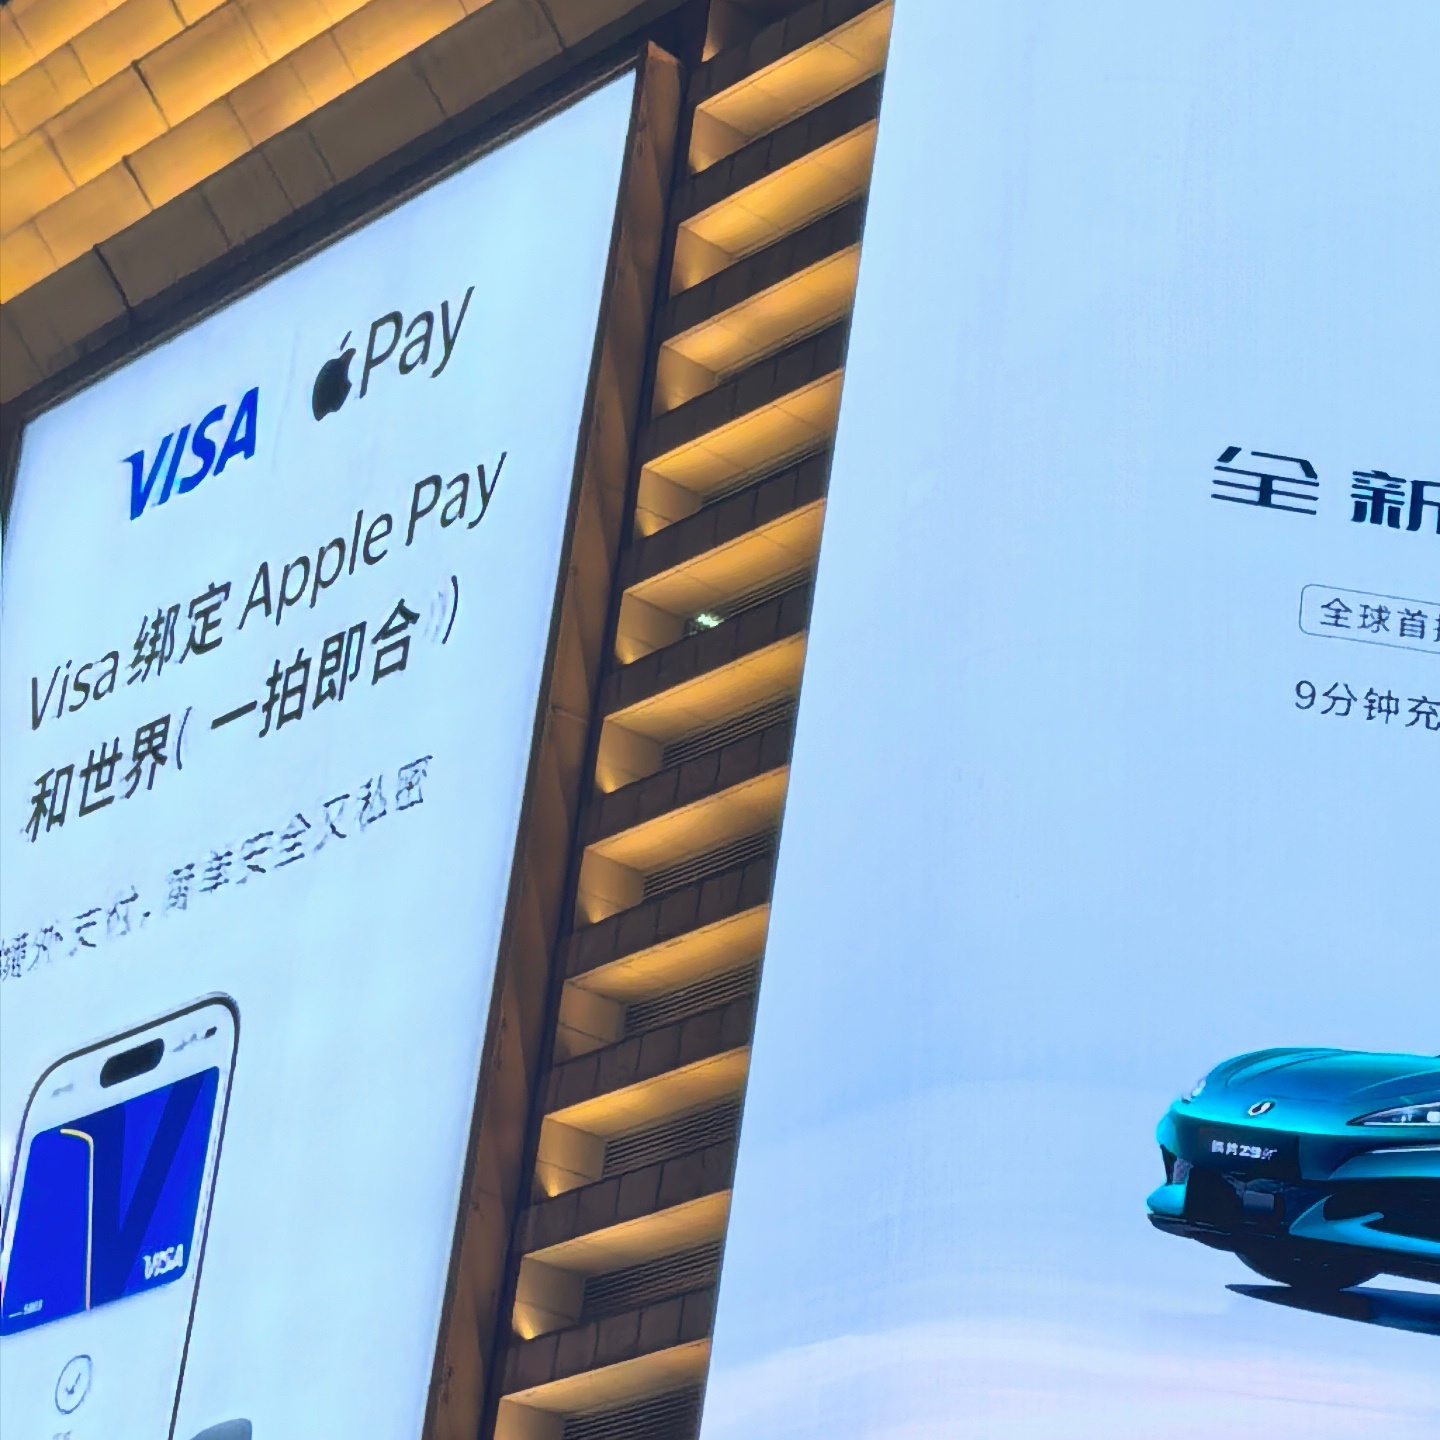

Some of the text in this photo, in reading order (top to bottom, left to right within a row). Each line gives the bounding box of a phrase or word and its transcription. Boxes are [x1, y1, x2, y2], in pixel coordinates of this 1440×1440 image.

[122, 387, 259, 521] VISA
[30, 451, 507, 731] Visa 绑定 Apple Pay
